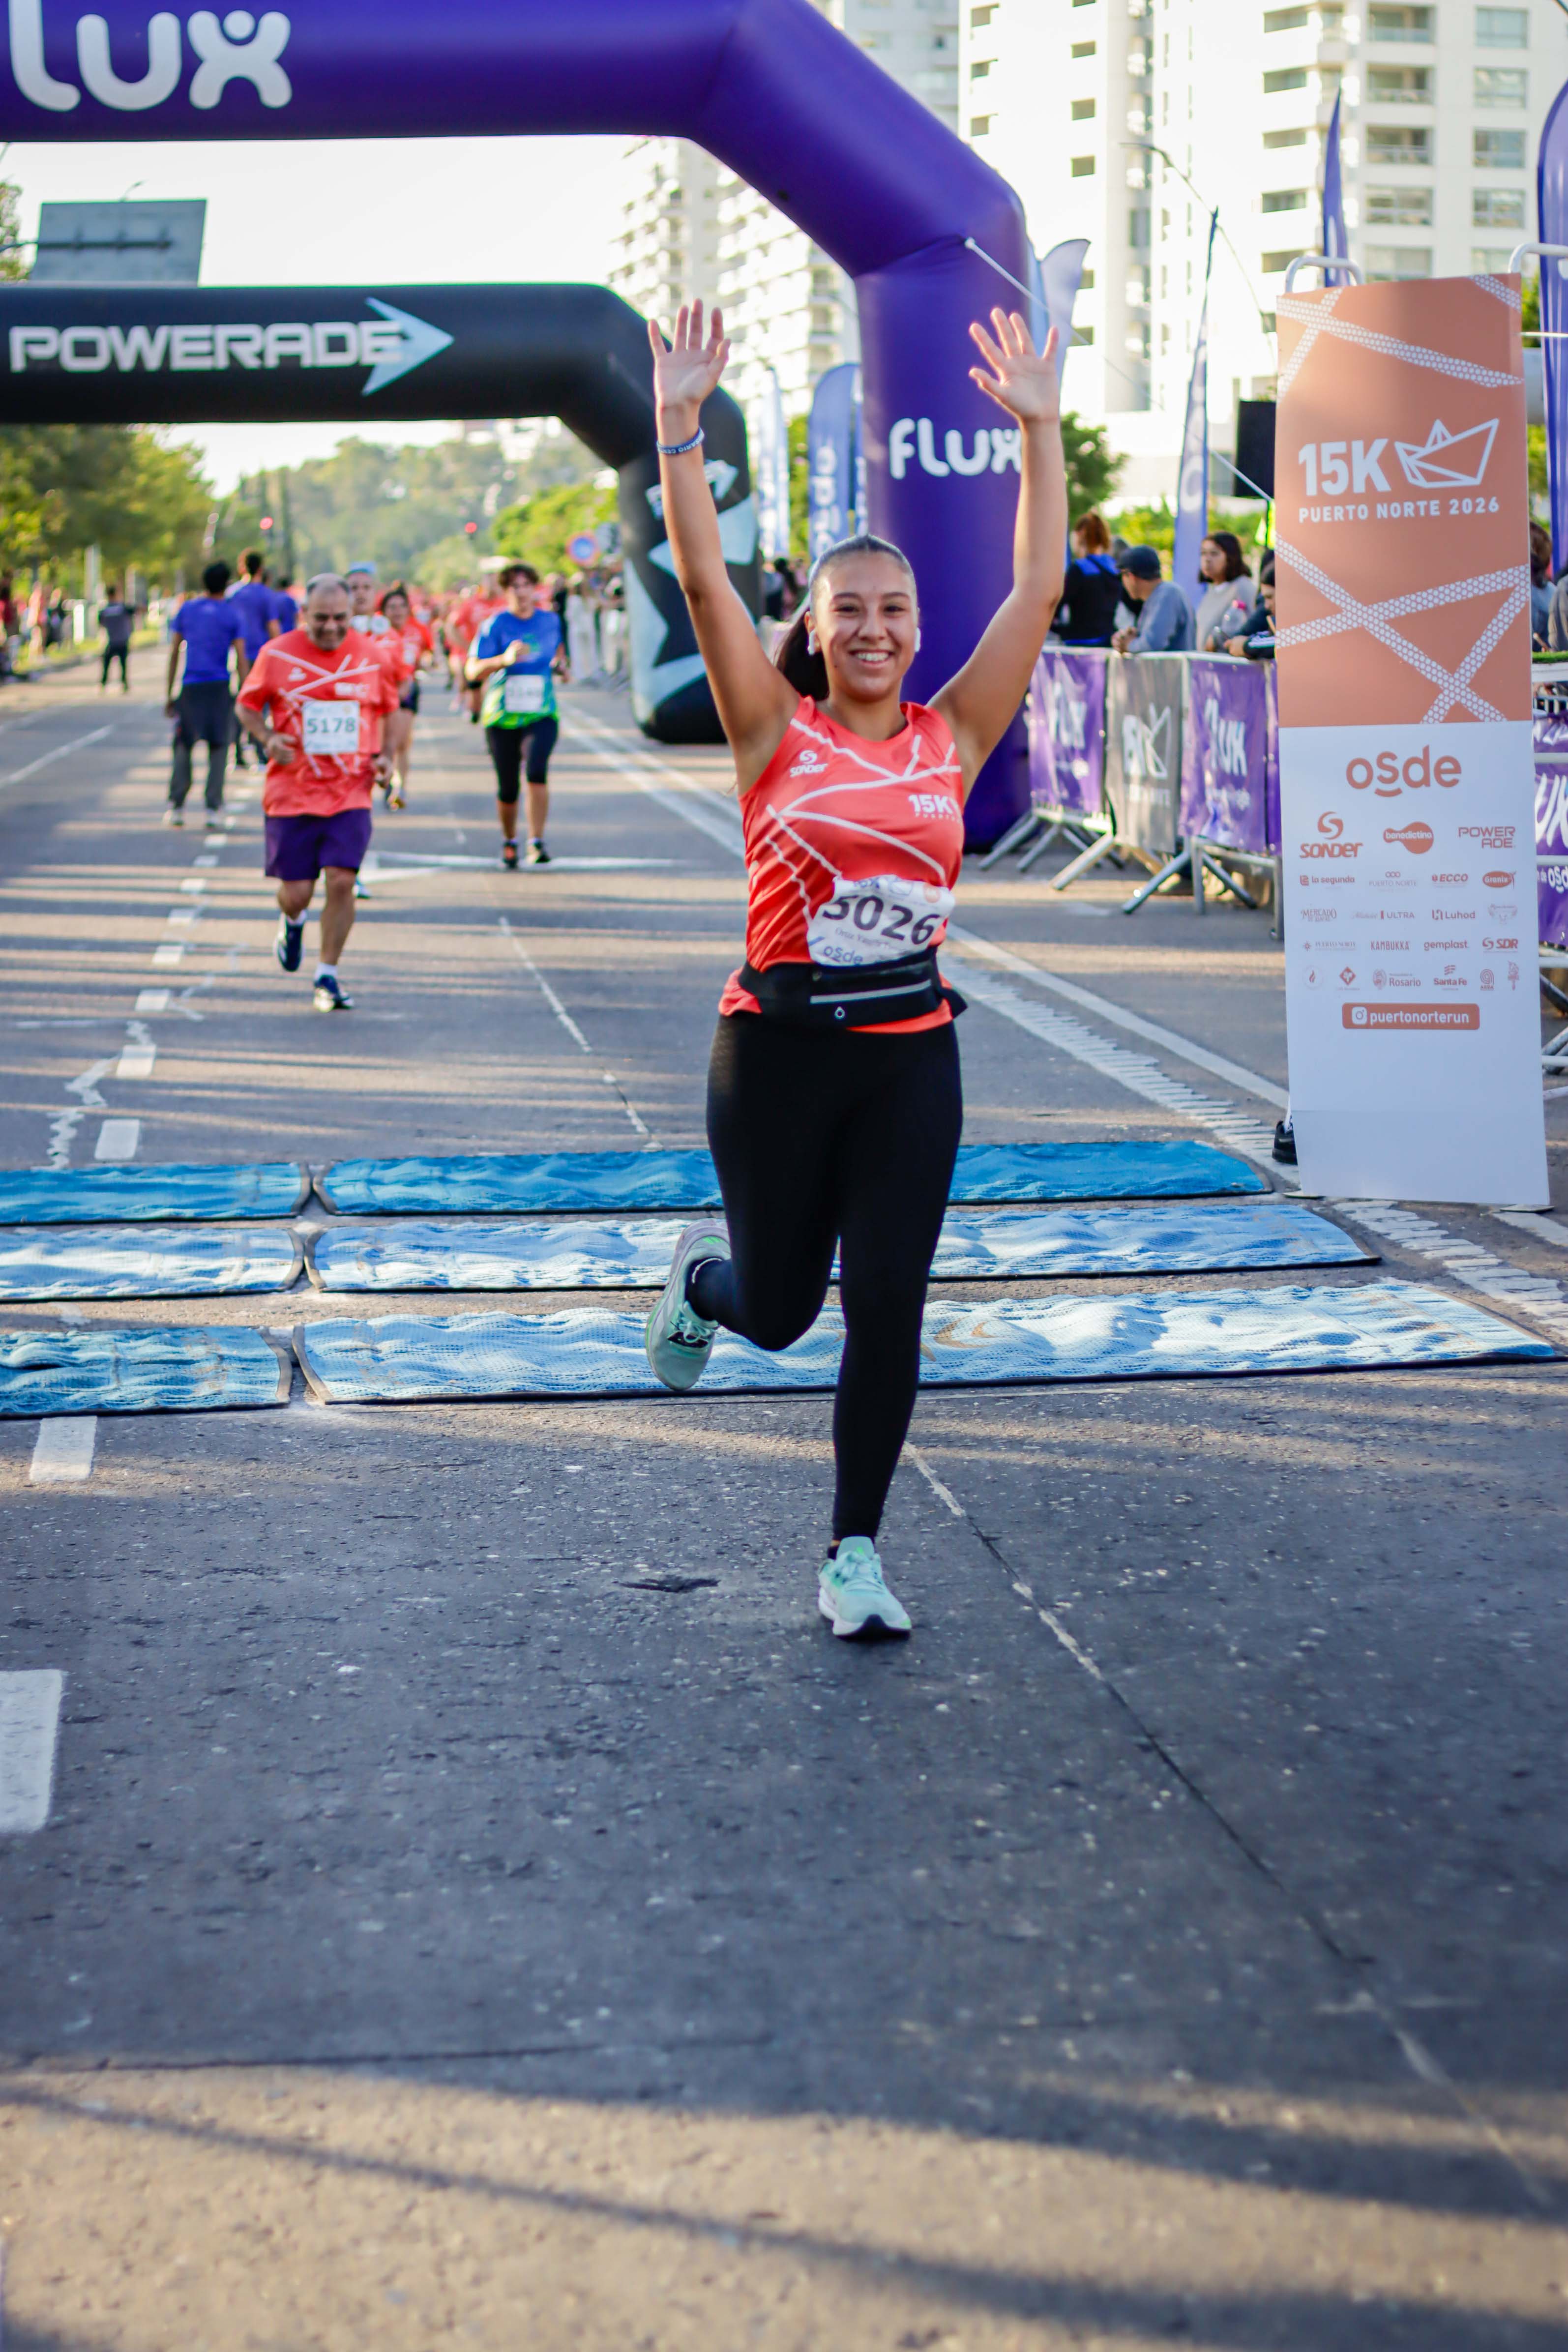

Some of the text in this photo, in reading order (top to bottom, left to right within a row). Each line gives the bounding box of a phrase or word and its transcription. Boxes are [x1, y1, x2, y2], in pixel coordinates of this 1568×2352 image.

[9, 0, 292, 112] lux
[8, 320, 402, 373] POWERADE
[1299, 439, 1391, 496] 15K
[1299, 497, 1500, 523] PUERTO NORTE 2026
[307, 717, 355, 734] 5178
[1346, 745, 1462, 797] osde
[908, 794, 953, 814] 15K
[1386, 830, 1432, 840] benedictino
[1458, 826, 1515, 838] POWER
[1481, 838, 1513, 849] ADE
[1311, 875, 1355, 884] la segunda
[1439, 874, 1469, 882] ECCO
[1548, 866, 1568, 888] osd
[822, 894, 941, 945] 5026
[1445, 911, 1476, 919] Luhod
[1370, 941, 1410, 951] KAMBUKKA
[1424, 940, 1468, 951] gemplast
[1496, 938, 1519, 949] SDR
[1389, 977, 1421, 987] Rosario
[1433, 977, 1468, 986] Santa Fe
[1370, 1010, 1469, 1026] puertonorterun
